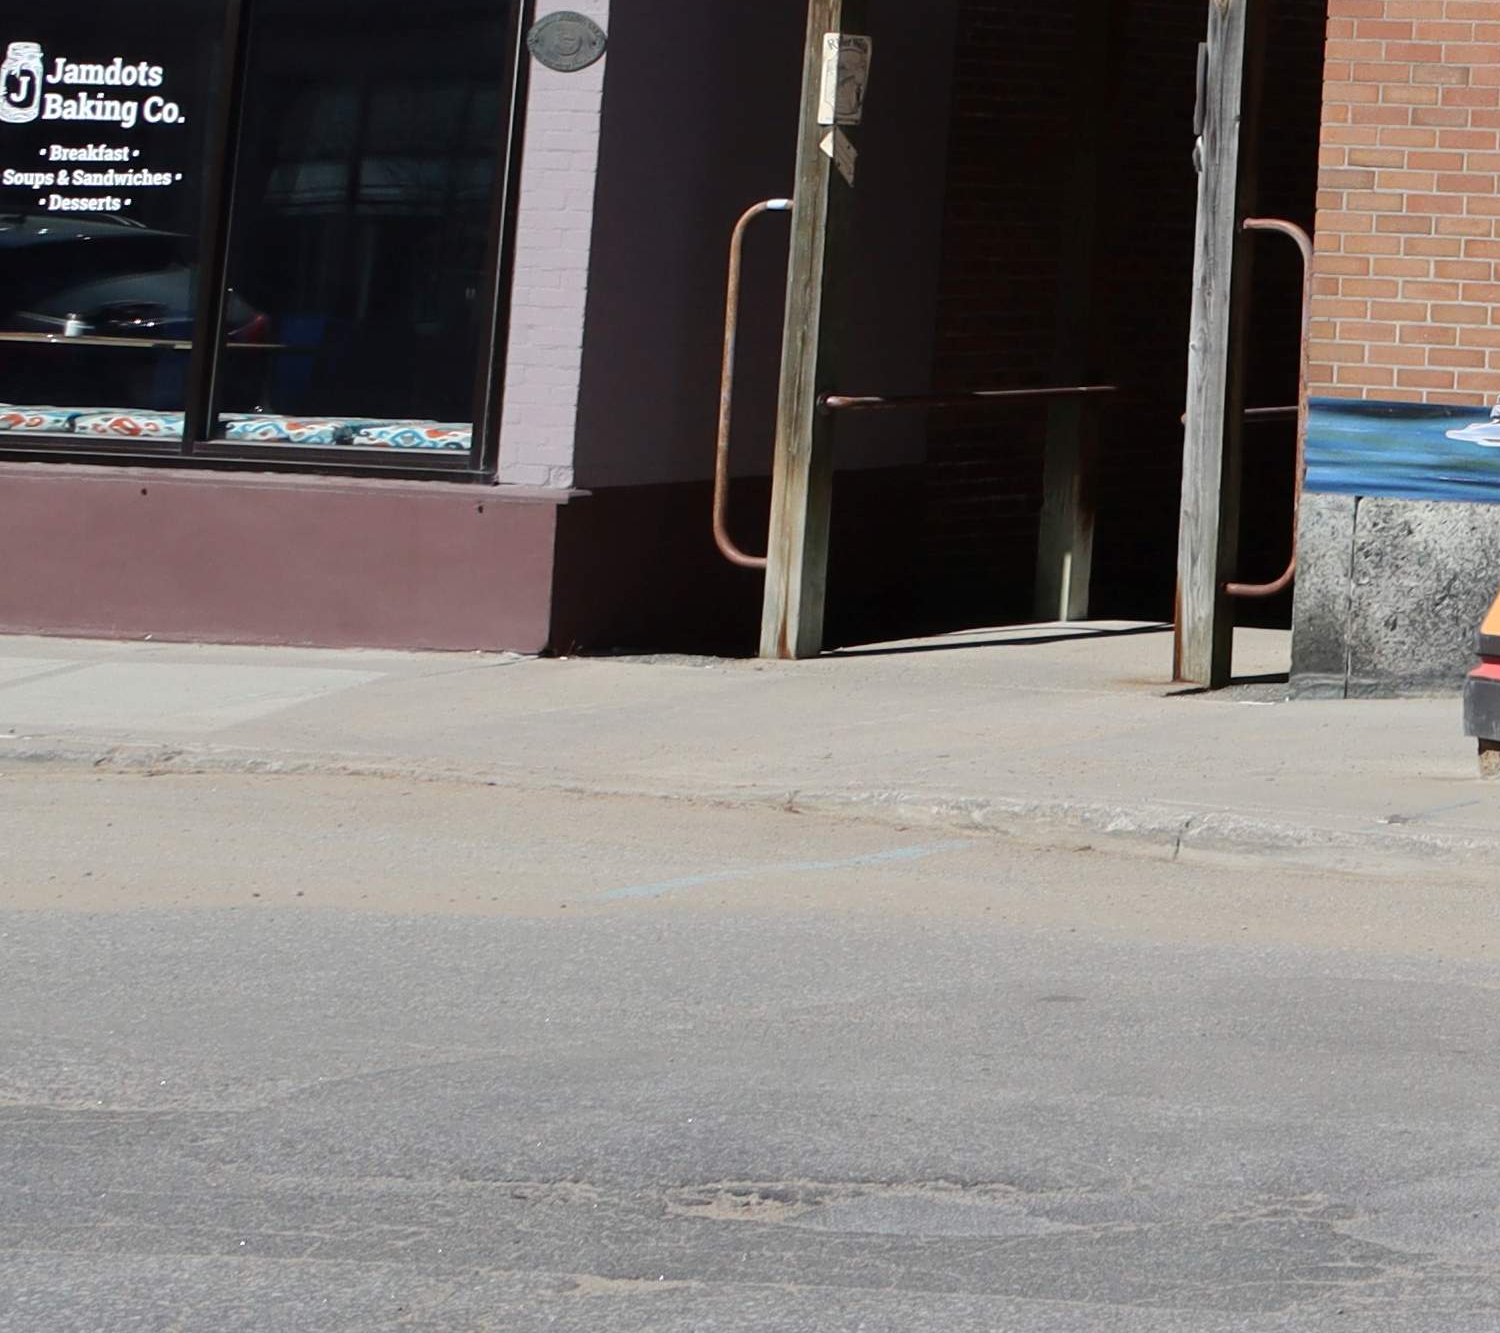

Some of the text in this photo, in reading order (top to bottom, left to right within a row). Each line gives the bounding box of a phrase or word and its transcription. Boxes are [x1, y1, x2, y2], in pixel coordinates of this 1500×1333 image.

[46, 57, 163, 87] Jamdots
[42, 92, 186, 129] Baking Co.
[48, 144, 130, 161] Breakfast
[2, 169, 172, 189] Soups & Sandwiches
[48, 194, 121, 211] Desserts
